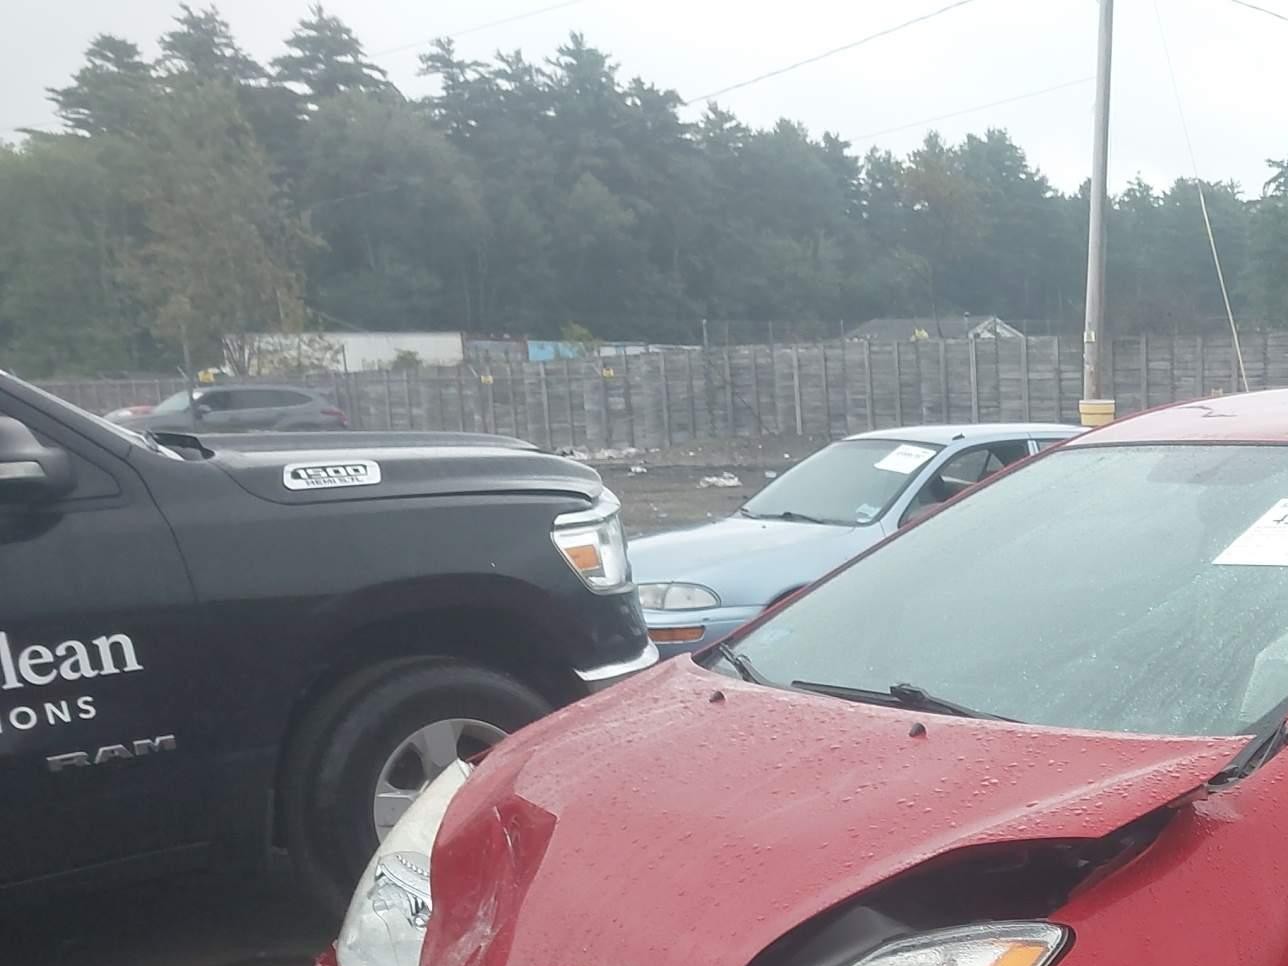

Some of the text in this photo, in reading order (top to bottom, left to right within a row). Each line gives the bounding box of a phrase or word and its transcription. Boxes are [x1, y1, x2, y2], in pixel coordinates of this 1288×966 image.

[295, 465, 367, 479] 1500
[0, 695, 96, 733] ONS
[46, 734, 176, 772] RAM
